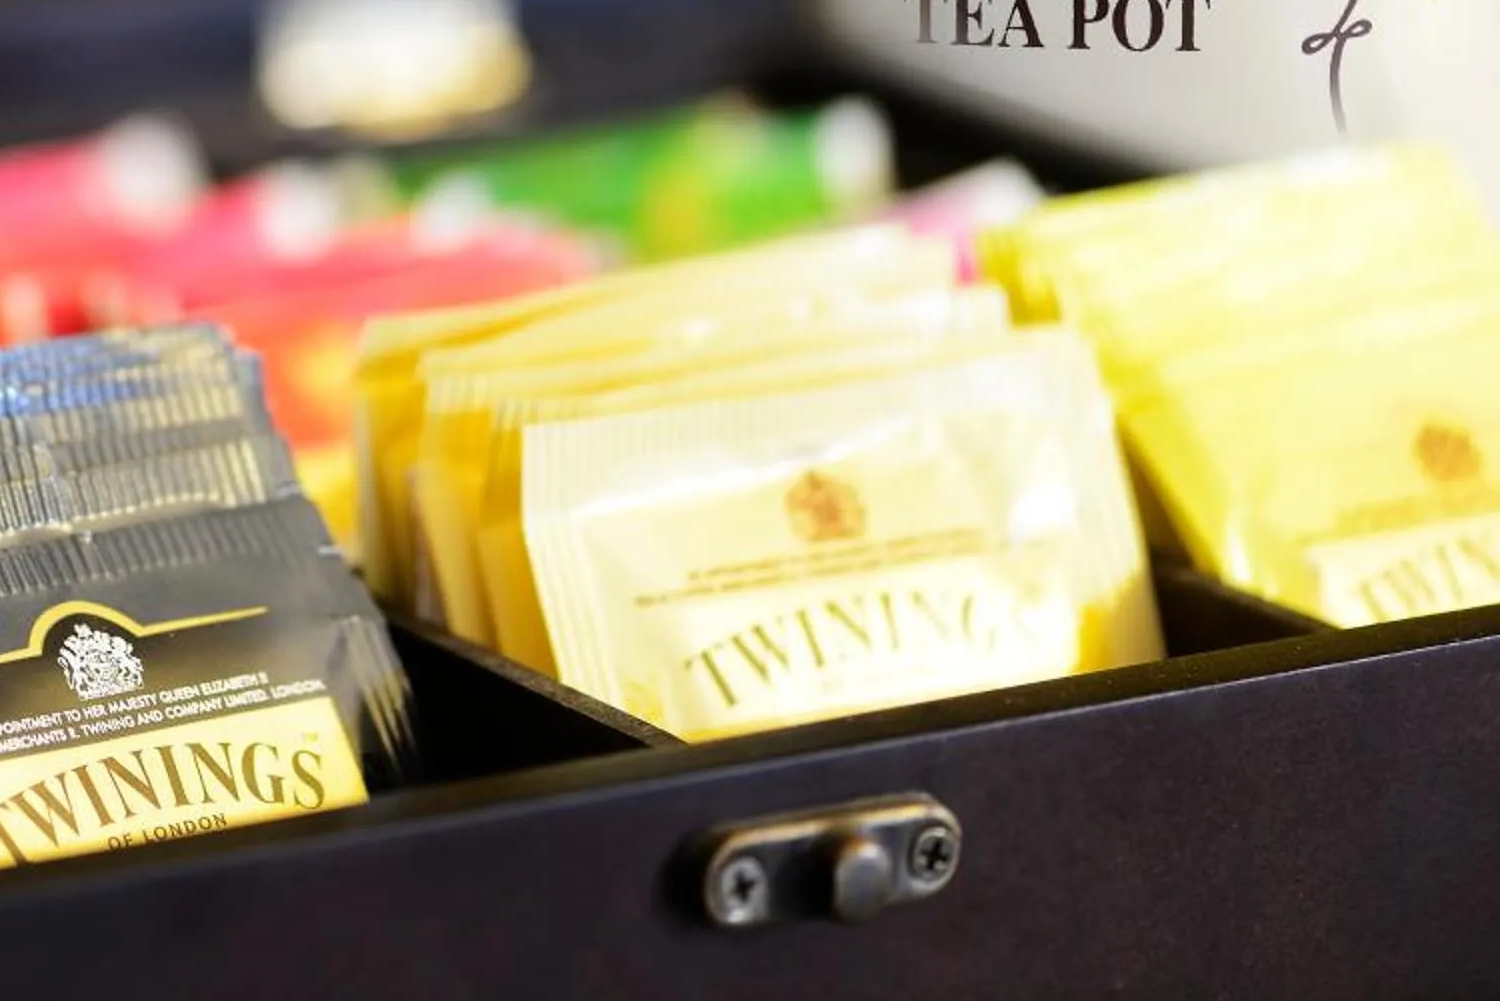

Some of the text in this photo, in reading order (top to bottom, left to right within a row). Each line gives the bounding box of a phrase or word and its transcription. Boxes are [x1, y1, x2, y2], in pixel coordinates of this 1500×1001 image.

[62, 708, 81, 723] TO
[82, 704, 107, 719] HER
[107, 694, 158, 714] MAJESTY
[159, 685, 200, 704] QUEEN
[80, 714, 135, 736] TWINING
[137, 709, 164, 726] AND
[164, 697, 223, 719] COMPANY
[107, 812, 228, 850] OF LONDON
